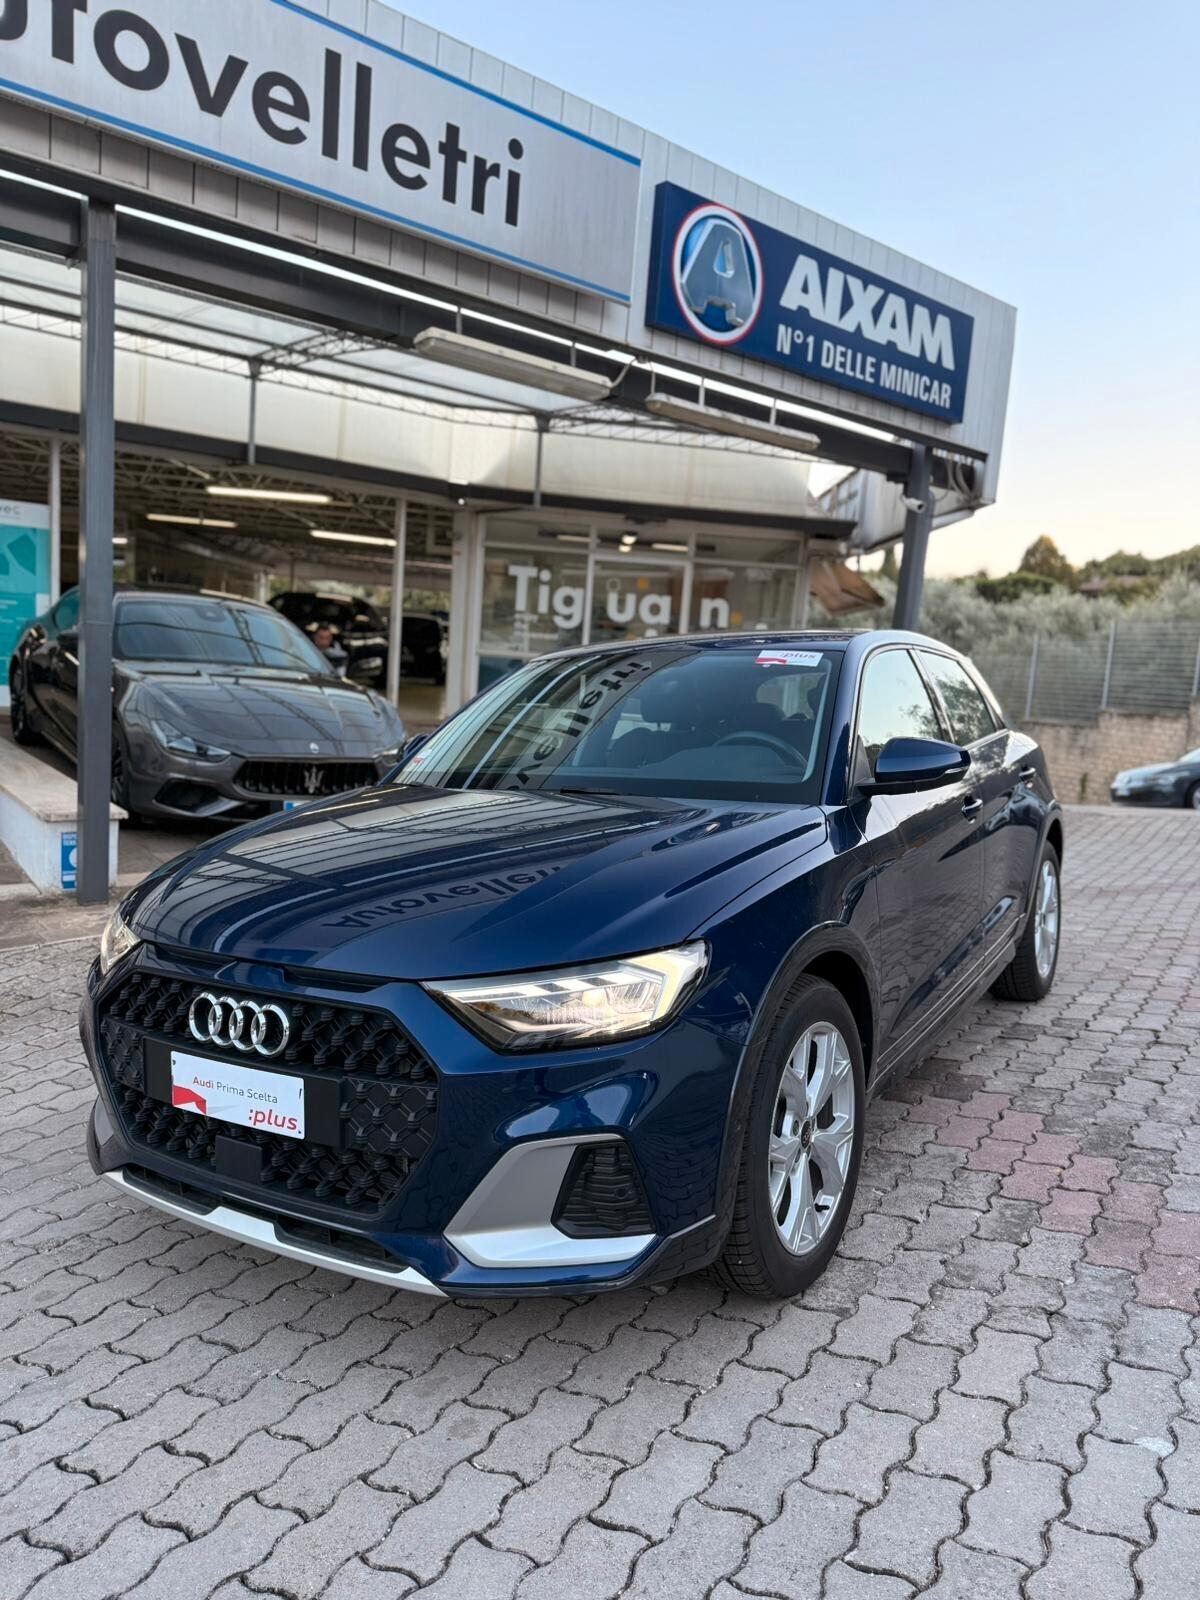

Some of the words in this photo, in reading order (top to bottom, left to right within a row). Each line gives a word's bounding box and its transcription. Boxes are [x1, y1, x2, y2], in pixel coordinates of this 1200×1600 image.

[779, 254, 955, 371] AIXAM
[821, 340, 876, 384] DELLE
[880, 362, 952, 410] MINICAR
[192, 1076, 214, 1089] Audi
[216, 1081, 244, 1096] Prima
[247, 1089, 278, 1104] Scelta
[248, 1109, 298, 1131] :plus
